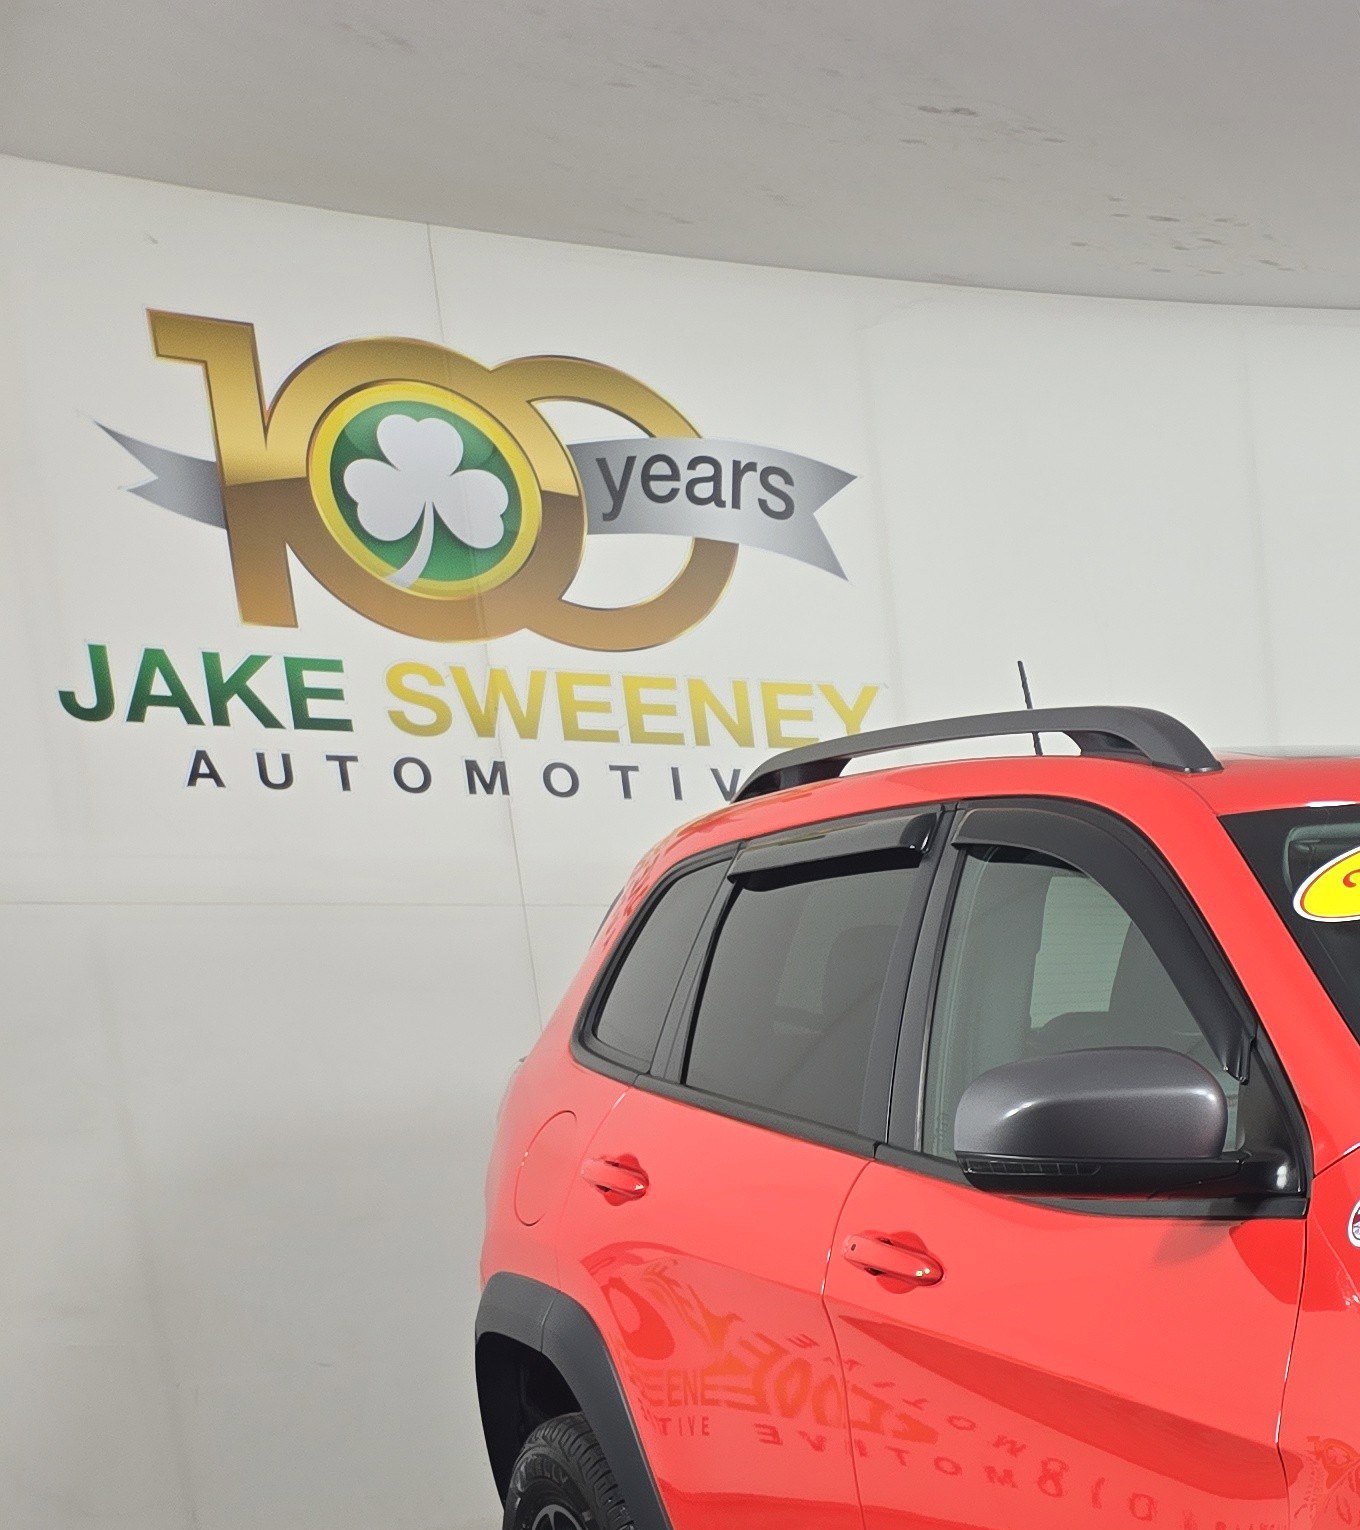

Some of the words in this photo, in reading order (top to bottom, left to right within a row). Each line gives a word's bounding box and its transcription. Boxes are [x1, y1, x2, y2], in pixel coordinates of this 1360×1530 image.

[596, 452, 797, 522] years
[58, 642, 354, 732] JAKE
[383, 661, 879, 748] SWEENEY
[186, 749, 741, 804] AUTOMOTIV
